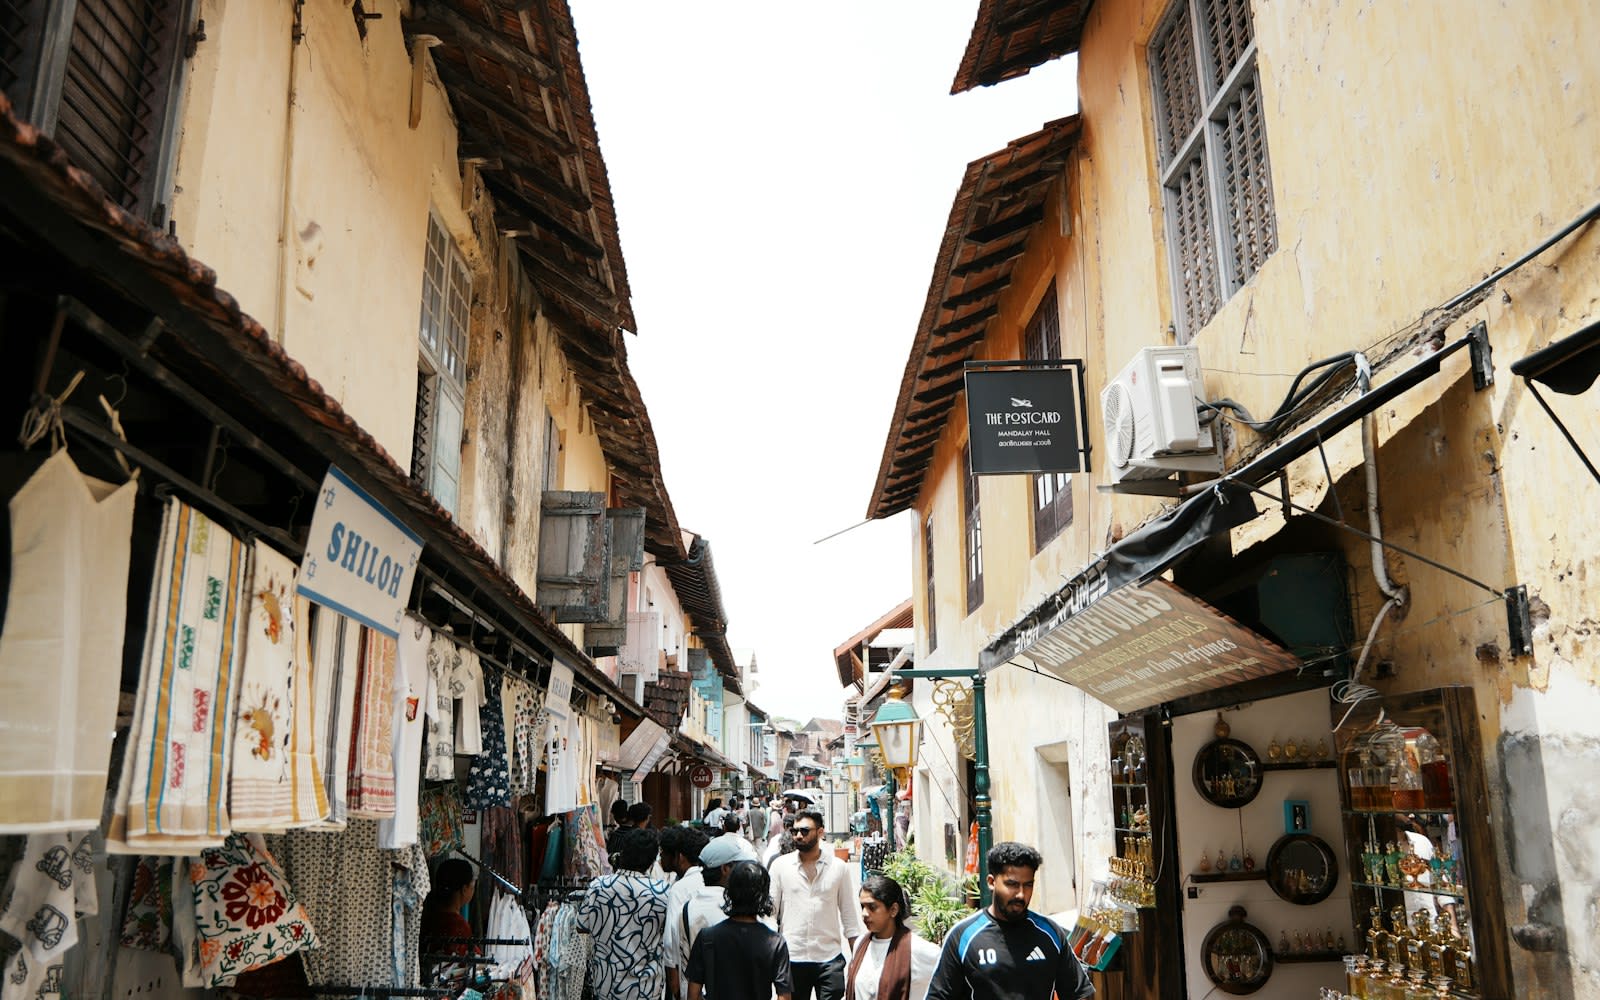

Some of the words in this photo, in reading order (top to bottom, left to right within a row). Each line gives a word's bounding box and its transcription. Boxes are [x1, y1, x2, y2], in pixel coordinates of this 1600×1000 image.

[985, 412, 1003, 425] THE
[1005, 411, 1061, 425] POSTCARD
[327, 521, 404, 599] SHILOH
[1026, 634, 1083, 667] SABA
[1058, 582, 1173, 650] PERFUMES
[1168, 615, 1208, 637] OILS
[1124, 666, 1157, 680] Your
[1146, 657, 1182, 673] Own
[1169, 637, 1238, 664] Perfumes
[978, 948, 997, 965] 10
